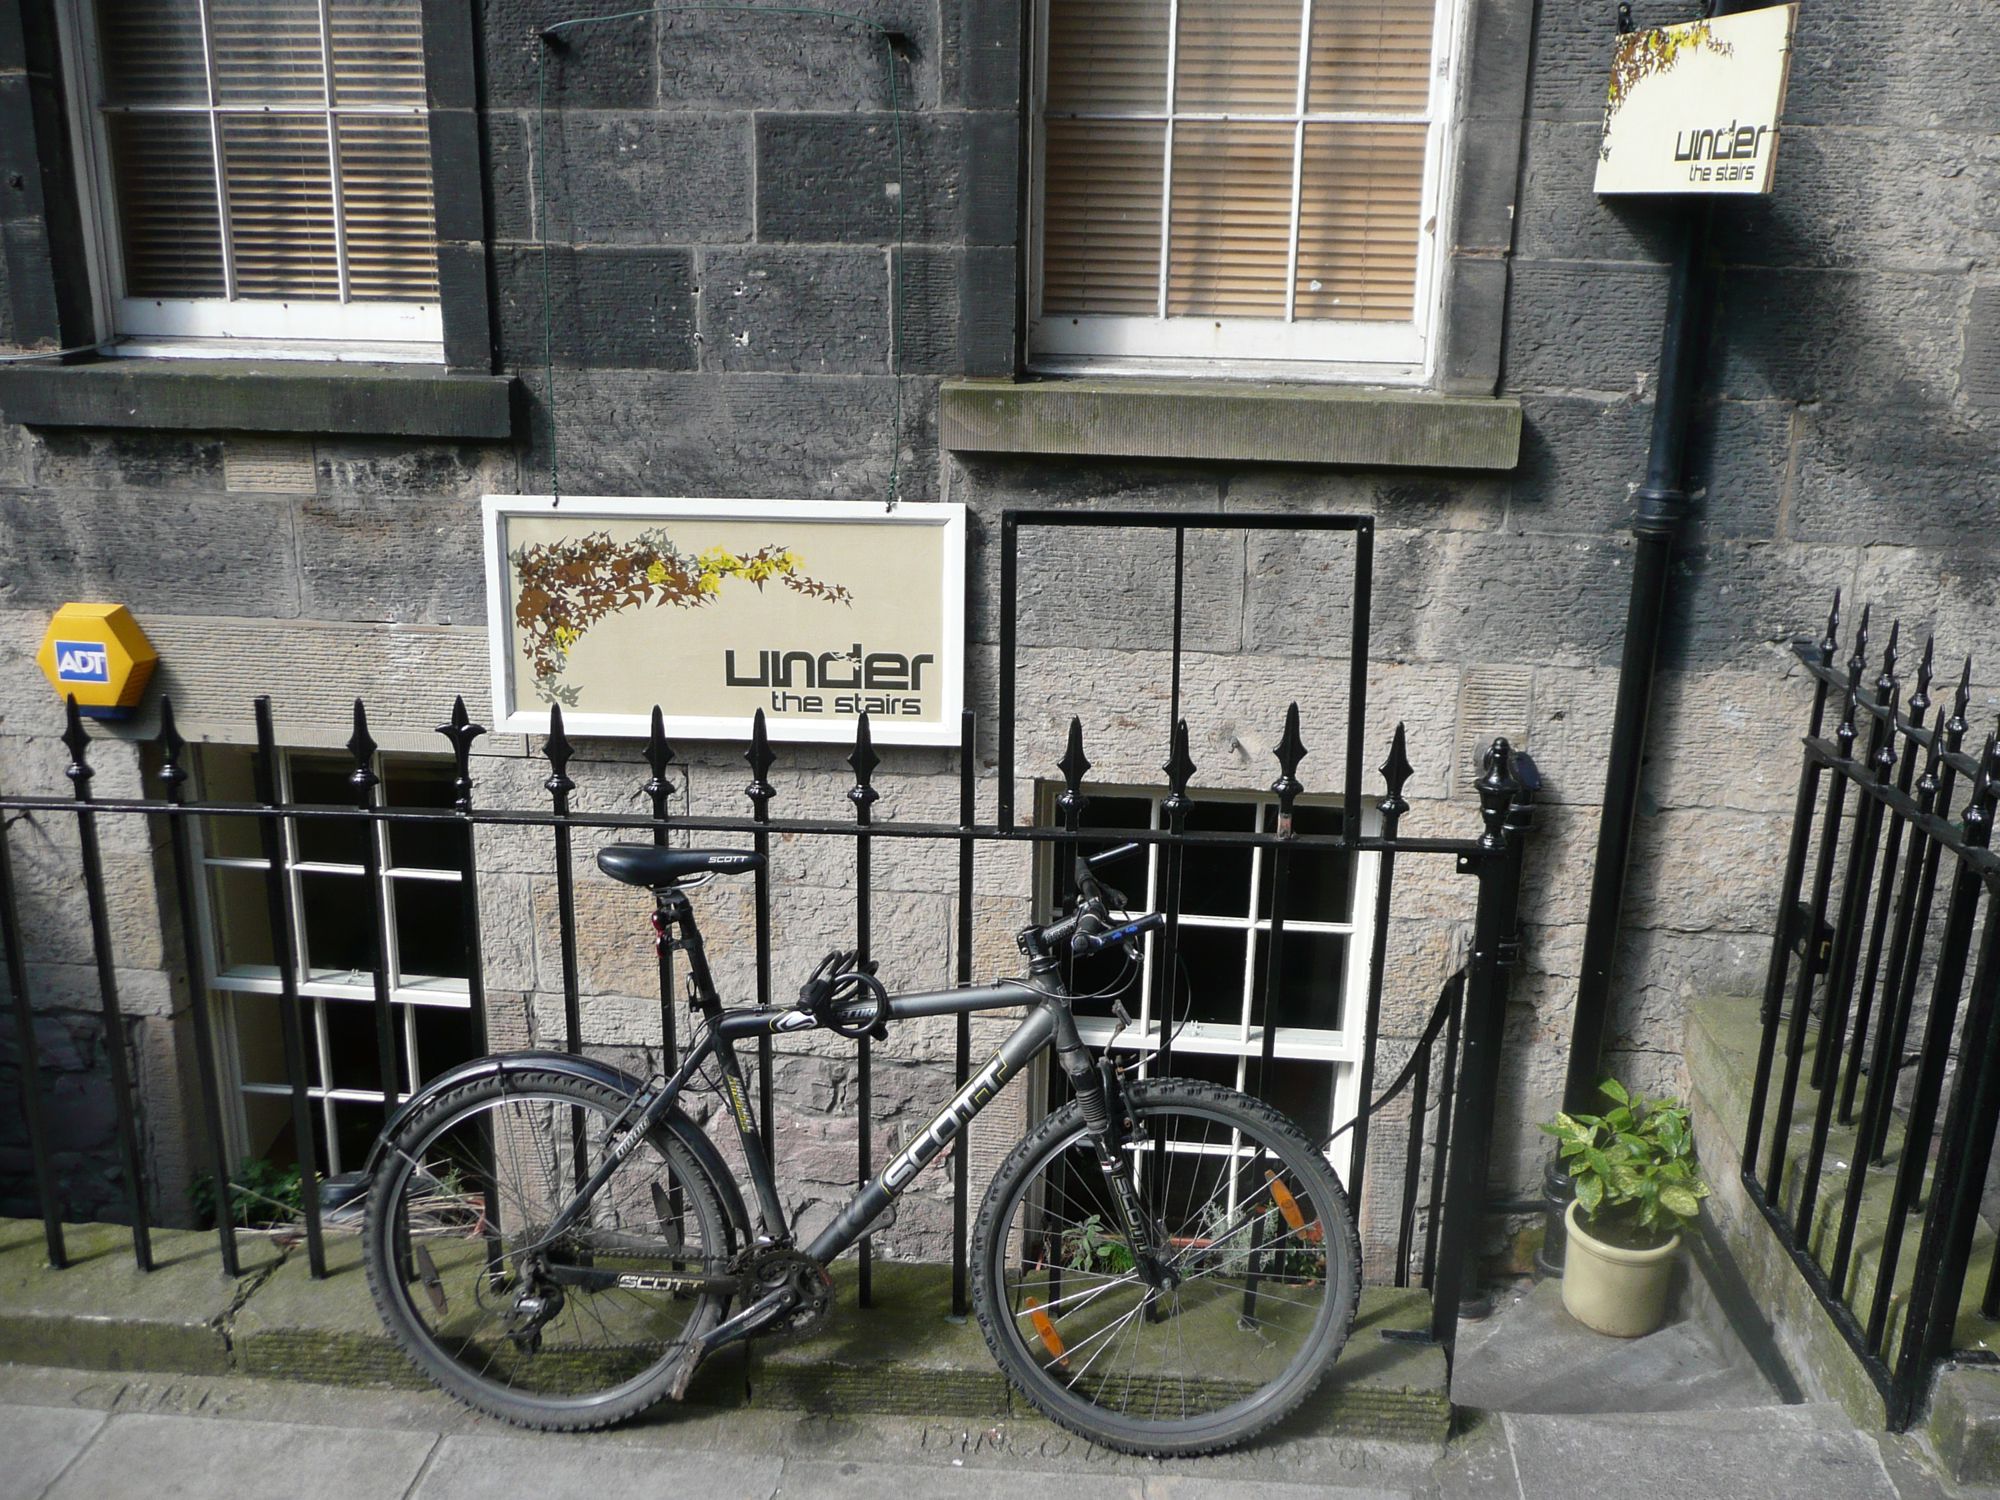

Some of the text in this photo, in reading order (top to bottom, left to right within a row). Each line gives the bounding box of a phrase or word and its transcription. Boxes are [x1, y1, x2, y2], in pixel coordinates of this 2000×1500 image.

[1674, 119, 1767, 161] under
[1689, 163, 1755, 181] the stairs
[58, 650, 107, 675] ADT
[725, 643, 934, 691] under
[772, 691, 921, 715] the stairs
[708, 855, 749, 864] SCOTT
[884, 1060, 1000, 1187] SCOTT
[1114, 1176, 1149, 1255] SCOTT
[618, 1275, 705, 1292] SCOTT
